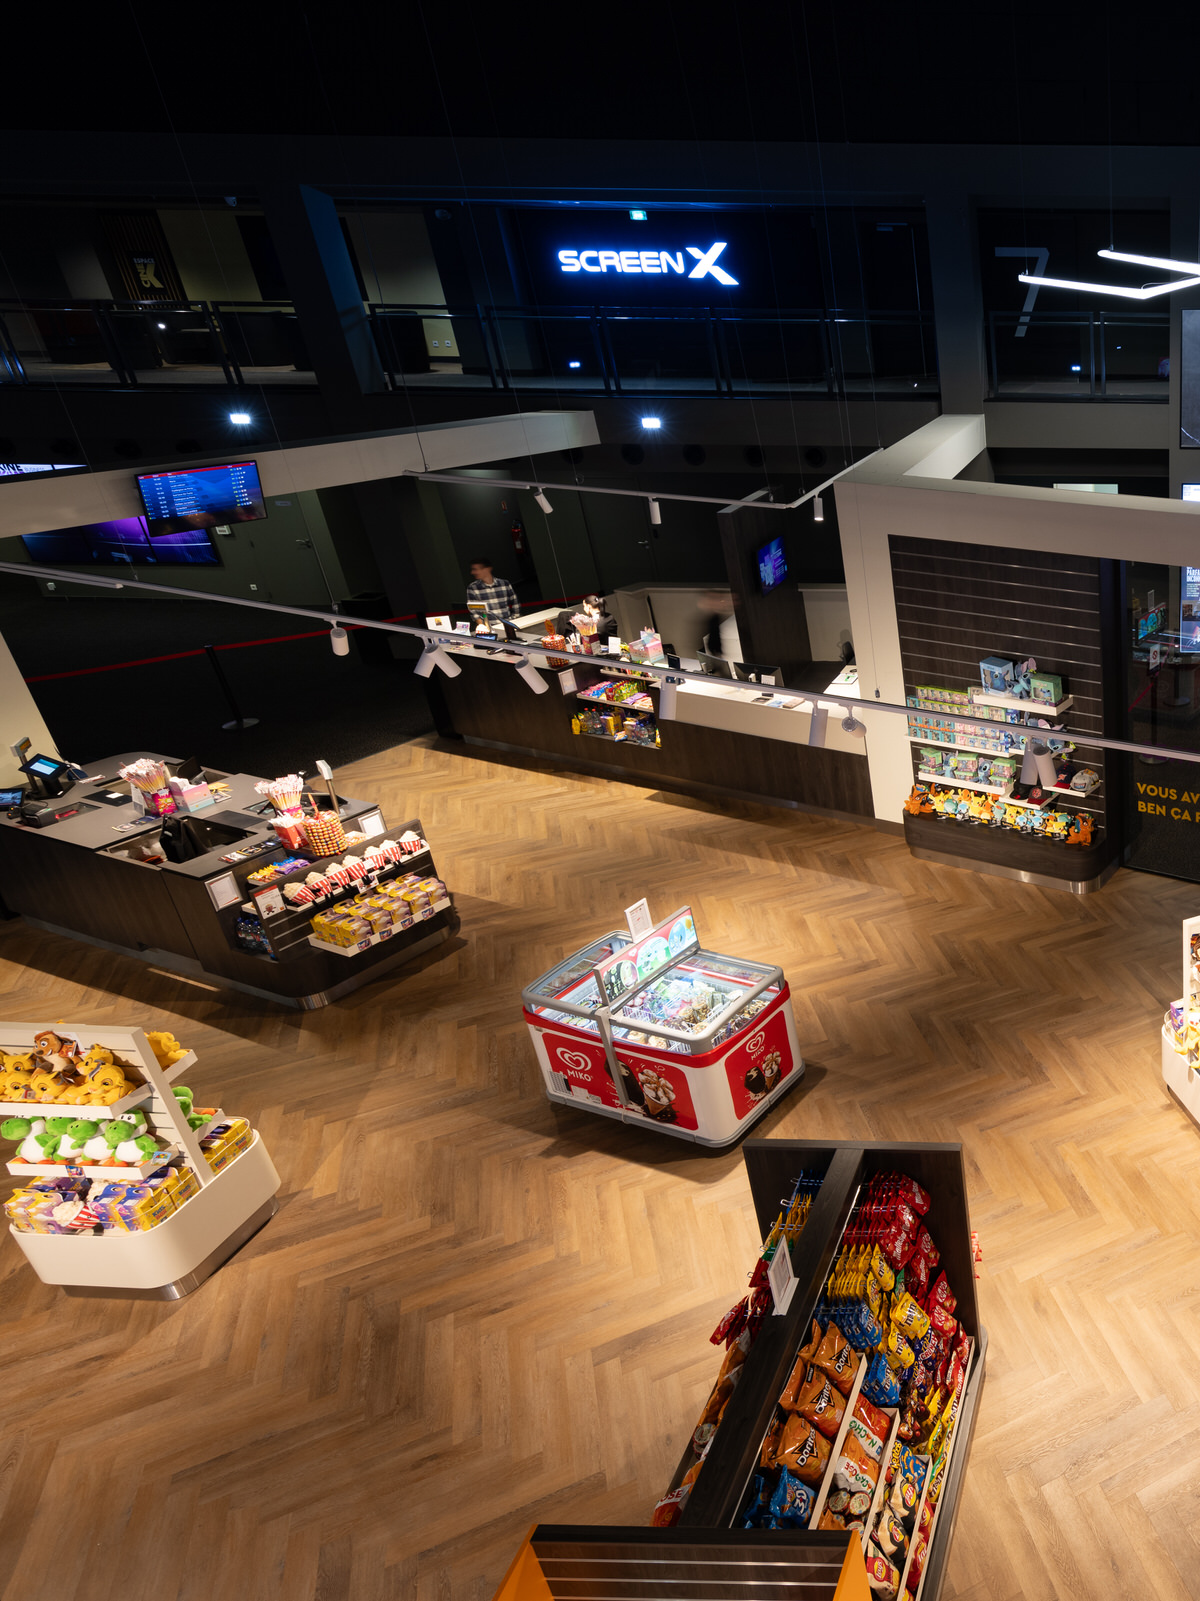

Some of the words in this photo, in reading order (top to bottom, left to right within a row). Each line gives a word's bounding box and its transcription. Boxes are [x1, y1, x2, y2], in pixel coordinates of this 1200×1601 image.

[558, 241, 740, 285] SCREENX
[994, 247, 1050, 337] 7
[1136, 782, 1178, 801] VOUS
[1137, 801, 1168, 818] BEN
[1170, 807, 1193, 824] ÇA
[751, 1044, 765, 1061] MIKO
[567, 1067, 593, 1082] MIKO
[815, 1379, 831, 1415] Doritos
[796, 1427, 816, 1467] Doritos
